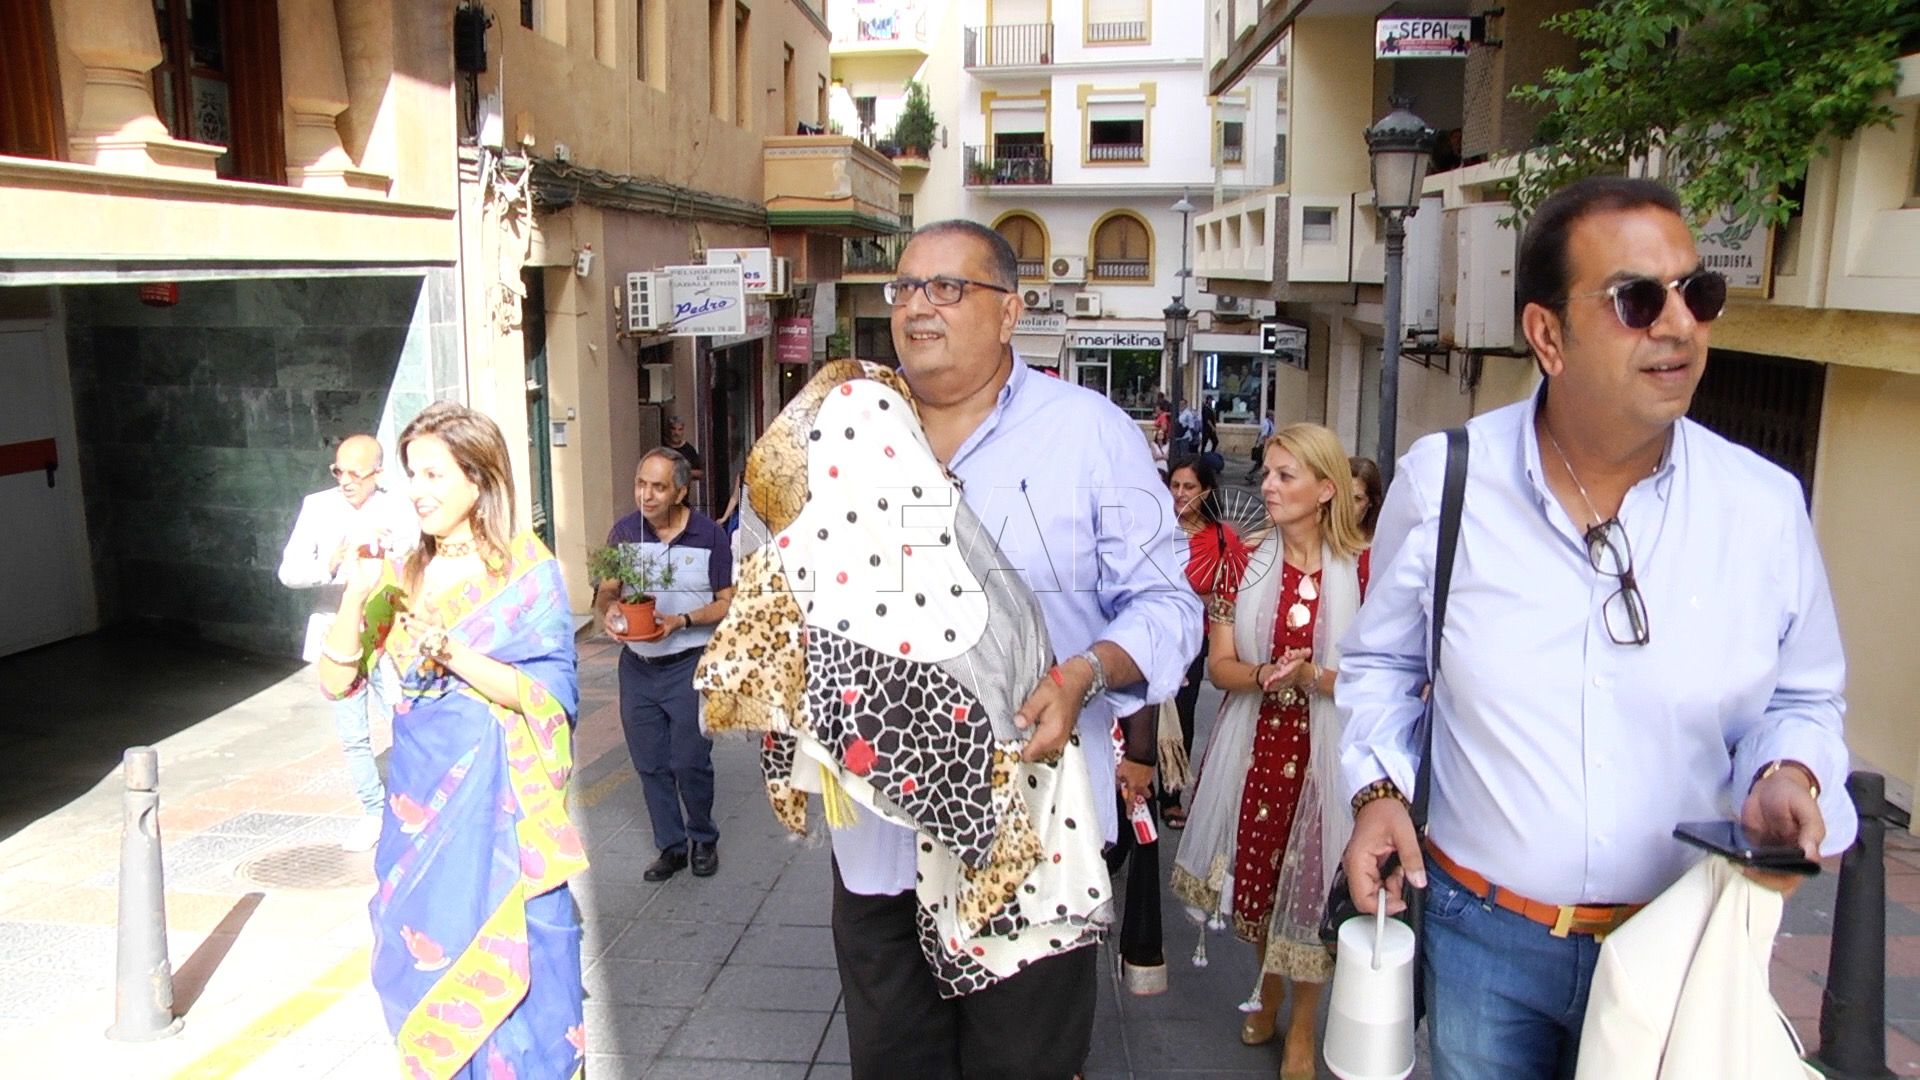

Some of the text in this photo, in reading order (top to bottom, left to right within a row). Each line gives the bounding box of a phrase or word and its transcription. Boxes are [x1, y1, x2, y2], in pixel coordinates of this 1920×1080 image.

[1400, 21, 1449, 39] SEPAI
[676, 297, 728, 318] Pedro
[1078, 333, 1161, 346] marikitina
